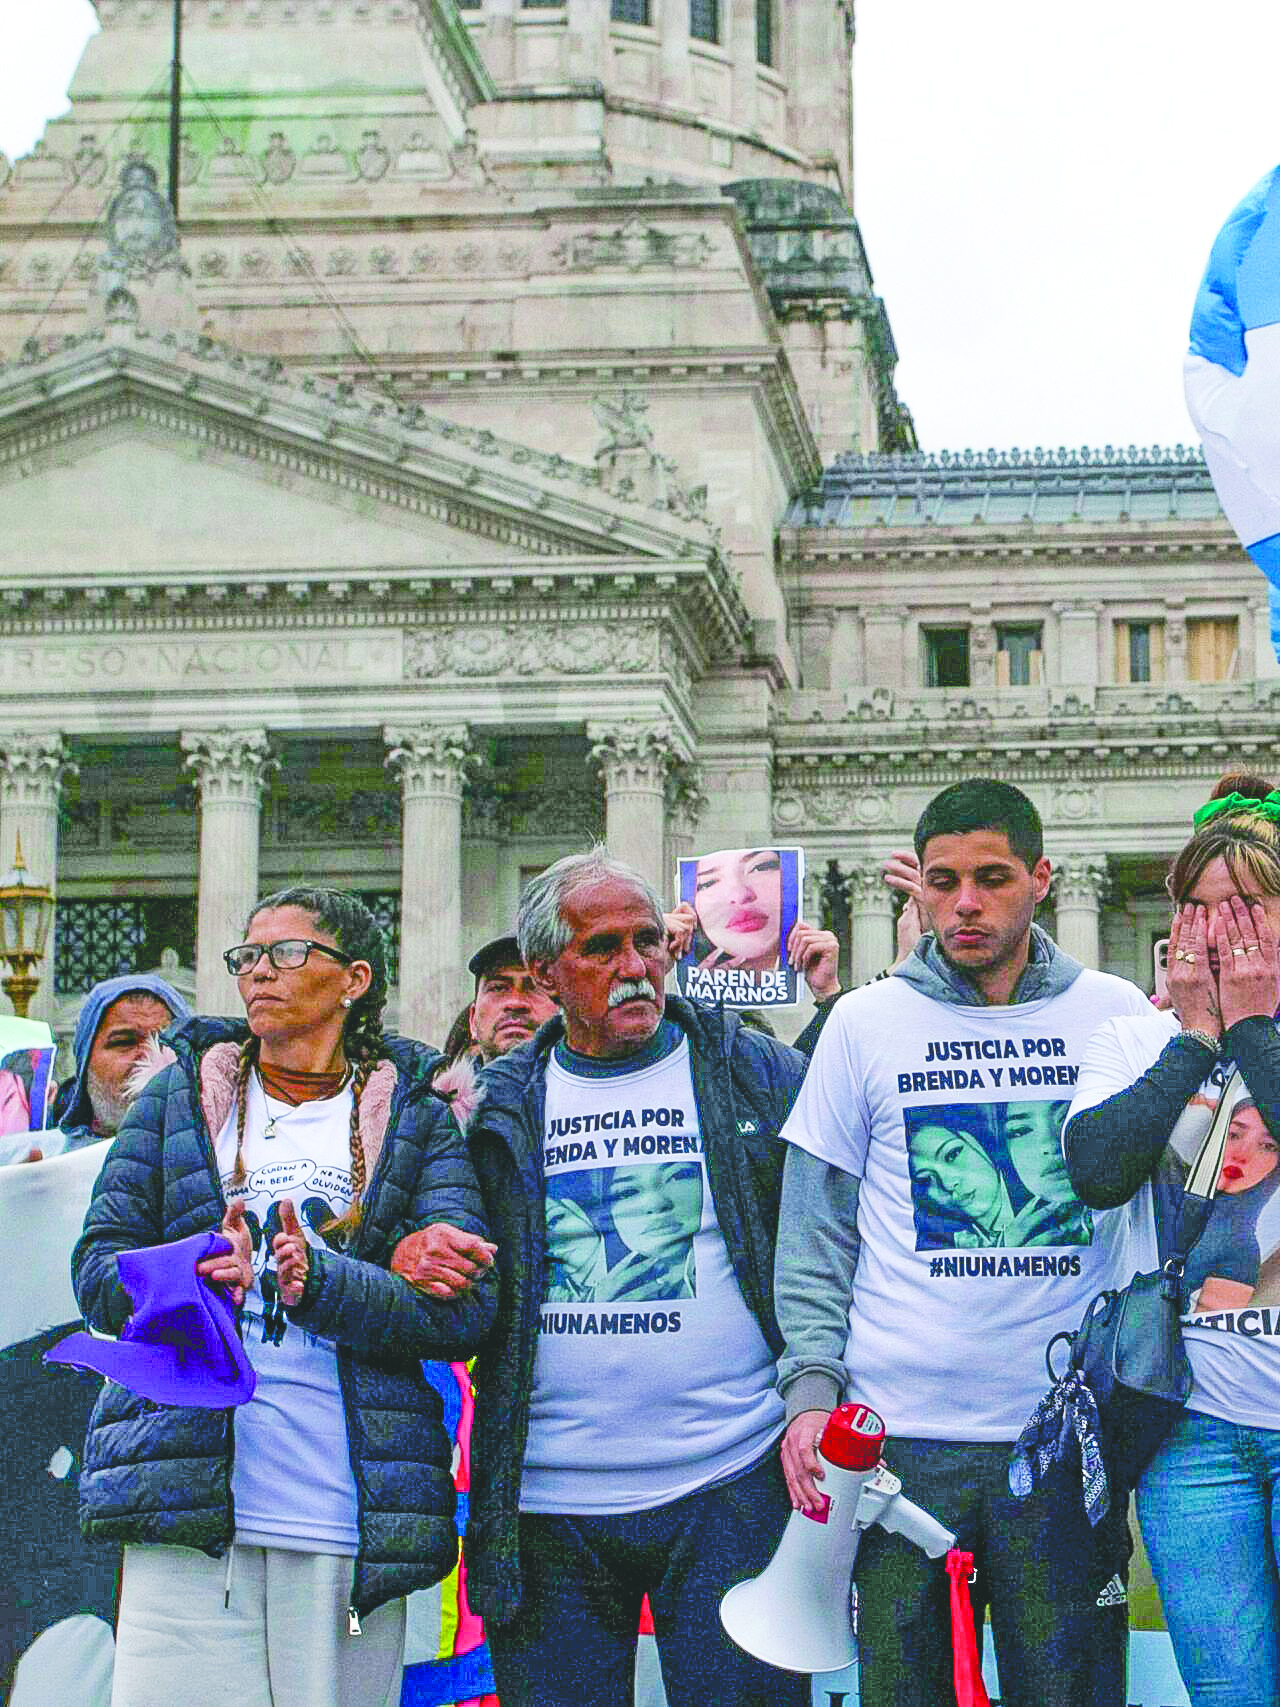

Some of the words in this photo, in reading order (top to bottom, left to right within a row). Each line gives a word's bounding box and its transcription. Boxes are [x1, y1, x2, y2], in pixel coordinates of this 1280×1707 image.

[0, 646, 127, 678] RESO
[156, 641, 363, 675] NACIONAL
[687, 966, 755, 987] PAREN
[761, 970, 786, 987] DE
[685, 982, 788, 1002] MATARNOS
[925, 1039, 1019, 1062] JUSTICIA
[1022, 1037, 1067, 1057] POR
[897, 1069, 985, 1093] BRENDA
[988, 1067, 1003, 1087] Y
[1009, 1065, 1080, 1086] MOREN
[548, 1109, 636, 1140] JUSTICIA
[641, 1107, 685, 1128] POR
[544, 1141, 598, 1168] ENDA
[603, 1138, 618, 1158] Y
[623, 1135, 700, 1157] MOREN
[930, 1254, 1081, 1278] #NIUNAMENOS
[538, 1311, 682, 1335] NIUNAMENOS
